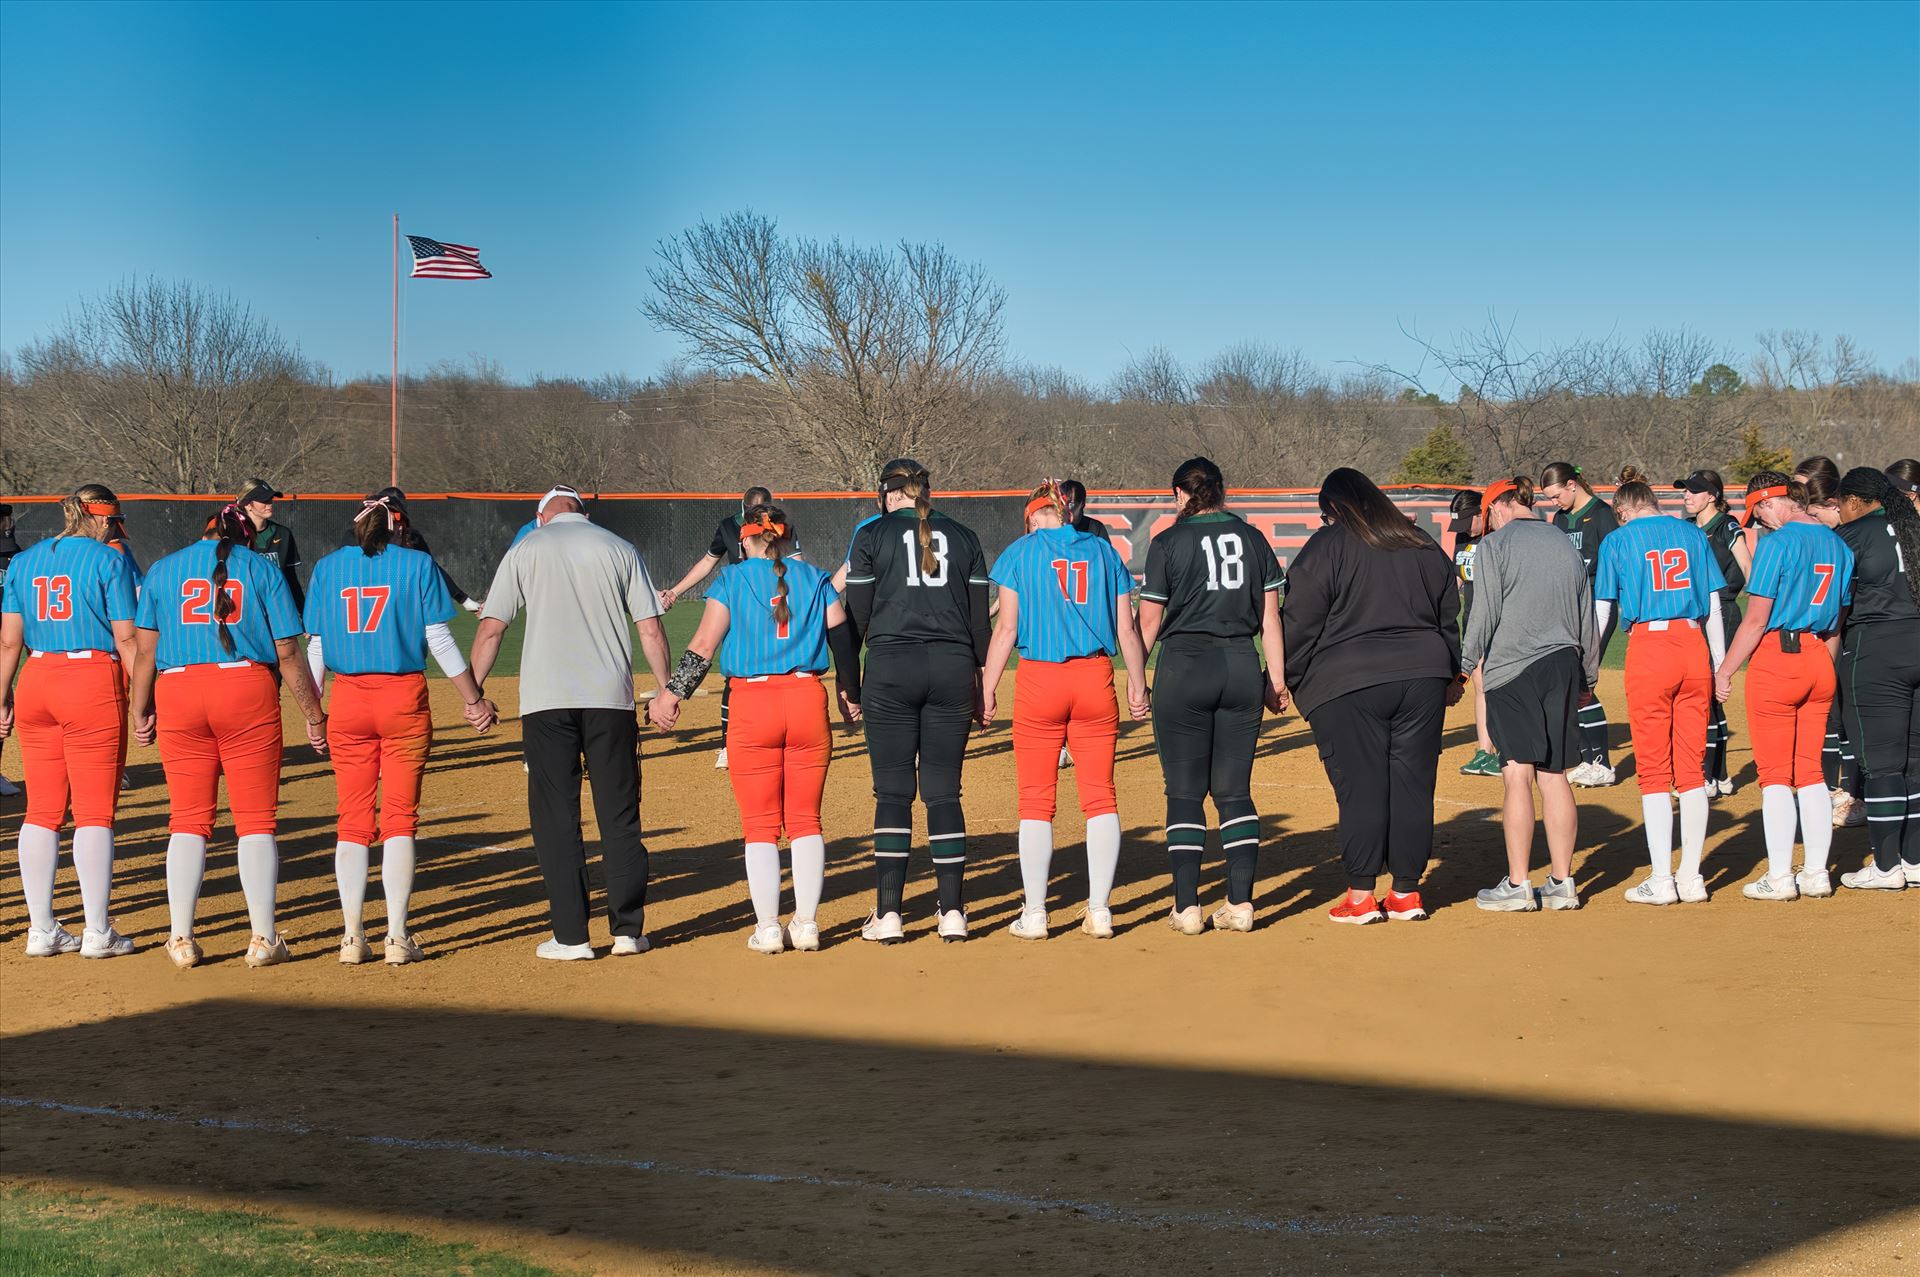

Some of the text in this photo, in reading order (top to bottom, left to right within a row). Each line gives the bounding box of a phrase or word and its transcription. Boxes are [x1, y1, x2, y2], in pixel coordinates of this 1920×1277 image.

[1051, 559, 1089, 604] 11
[1200, 533, 1244, 590] 18
[1645, 548, 1691, 591] 12
[32, 575, 73, 621] 13
[182, 579, 244, 624] 20
[1810, 564, 1835, 605] 7
[341, 585, 391, 633] 17
